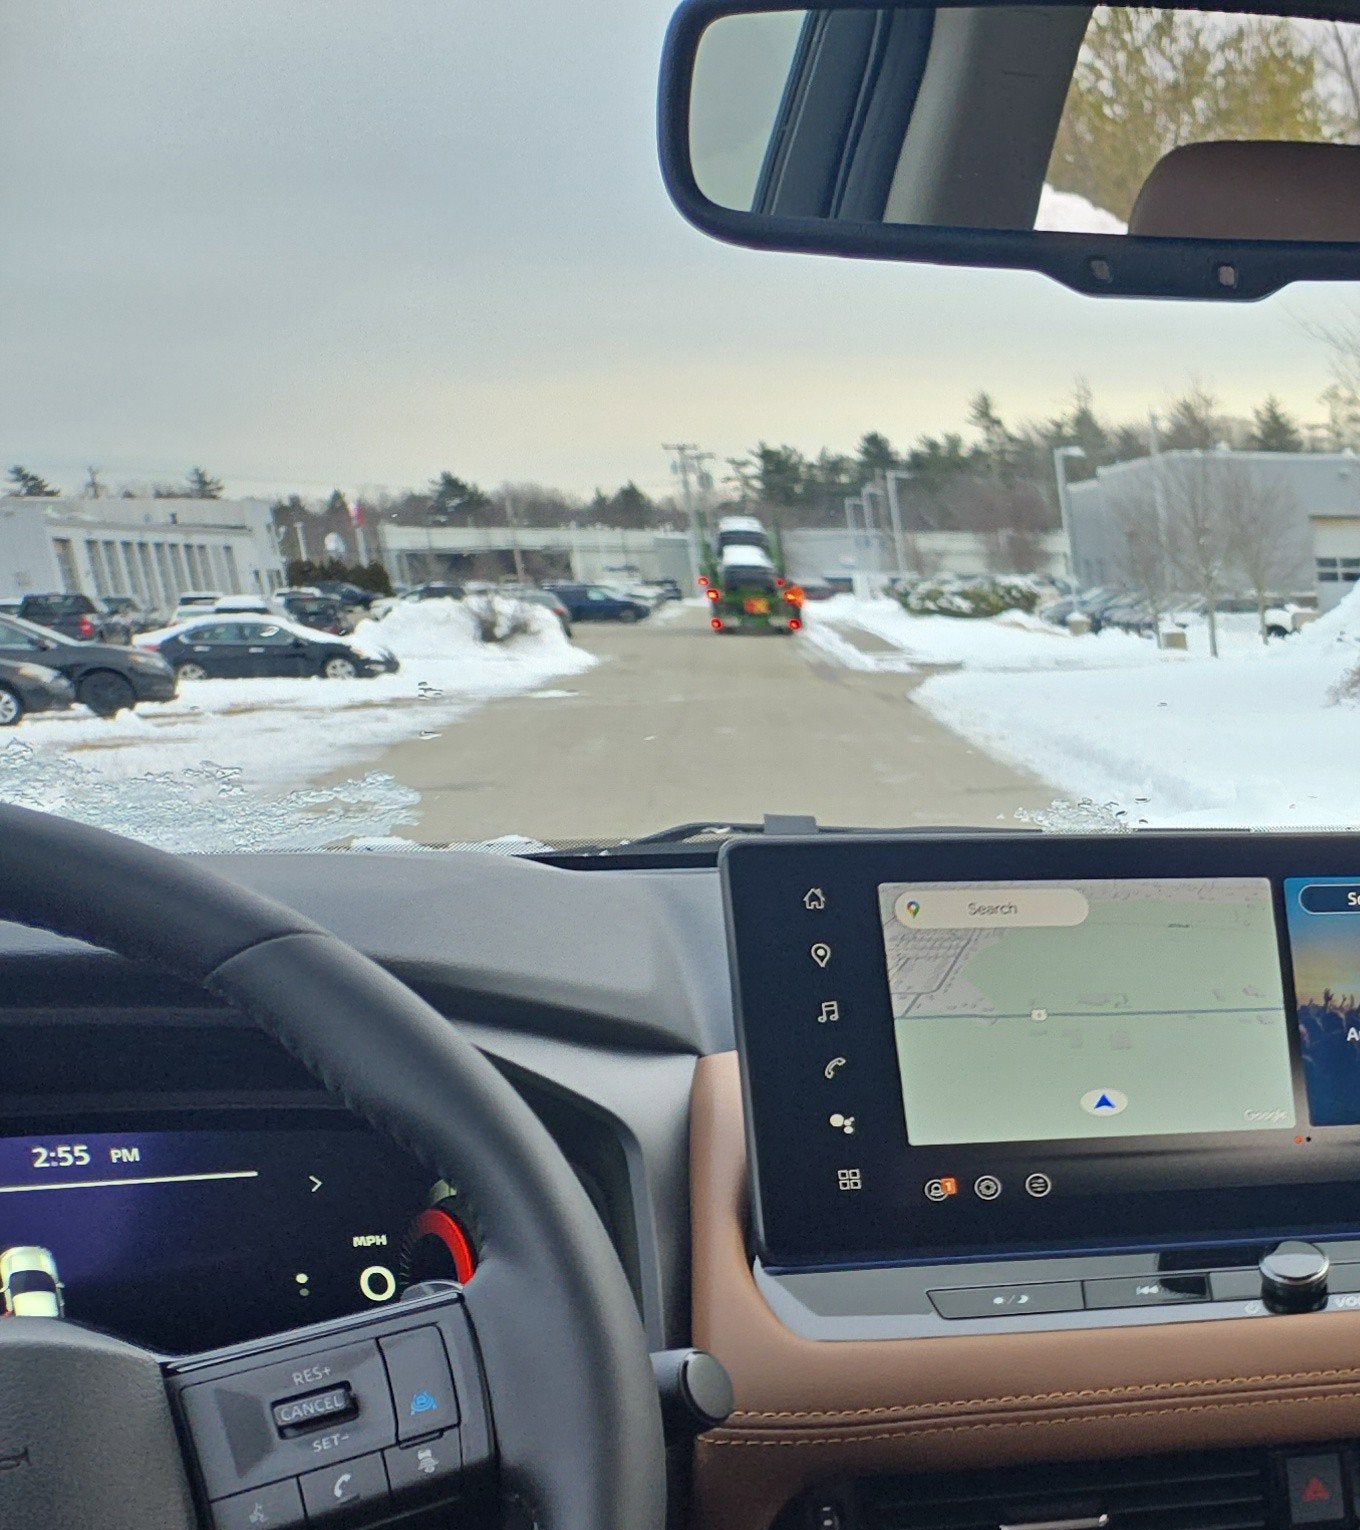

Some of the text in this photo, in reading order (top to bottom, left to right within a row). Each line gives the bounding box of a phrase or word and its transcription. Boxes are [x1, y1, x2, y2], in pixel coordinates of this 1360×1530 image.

[967, 901, 1018, 916] Search
[32, 1145, 141, 1168] 2:55 PM
[352, 1234, 388, 1248] MPH
[292, 1366, 331, 1386] RES+
[280, 1394, 345, 1421] CANCEL
